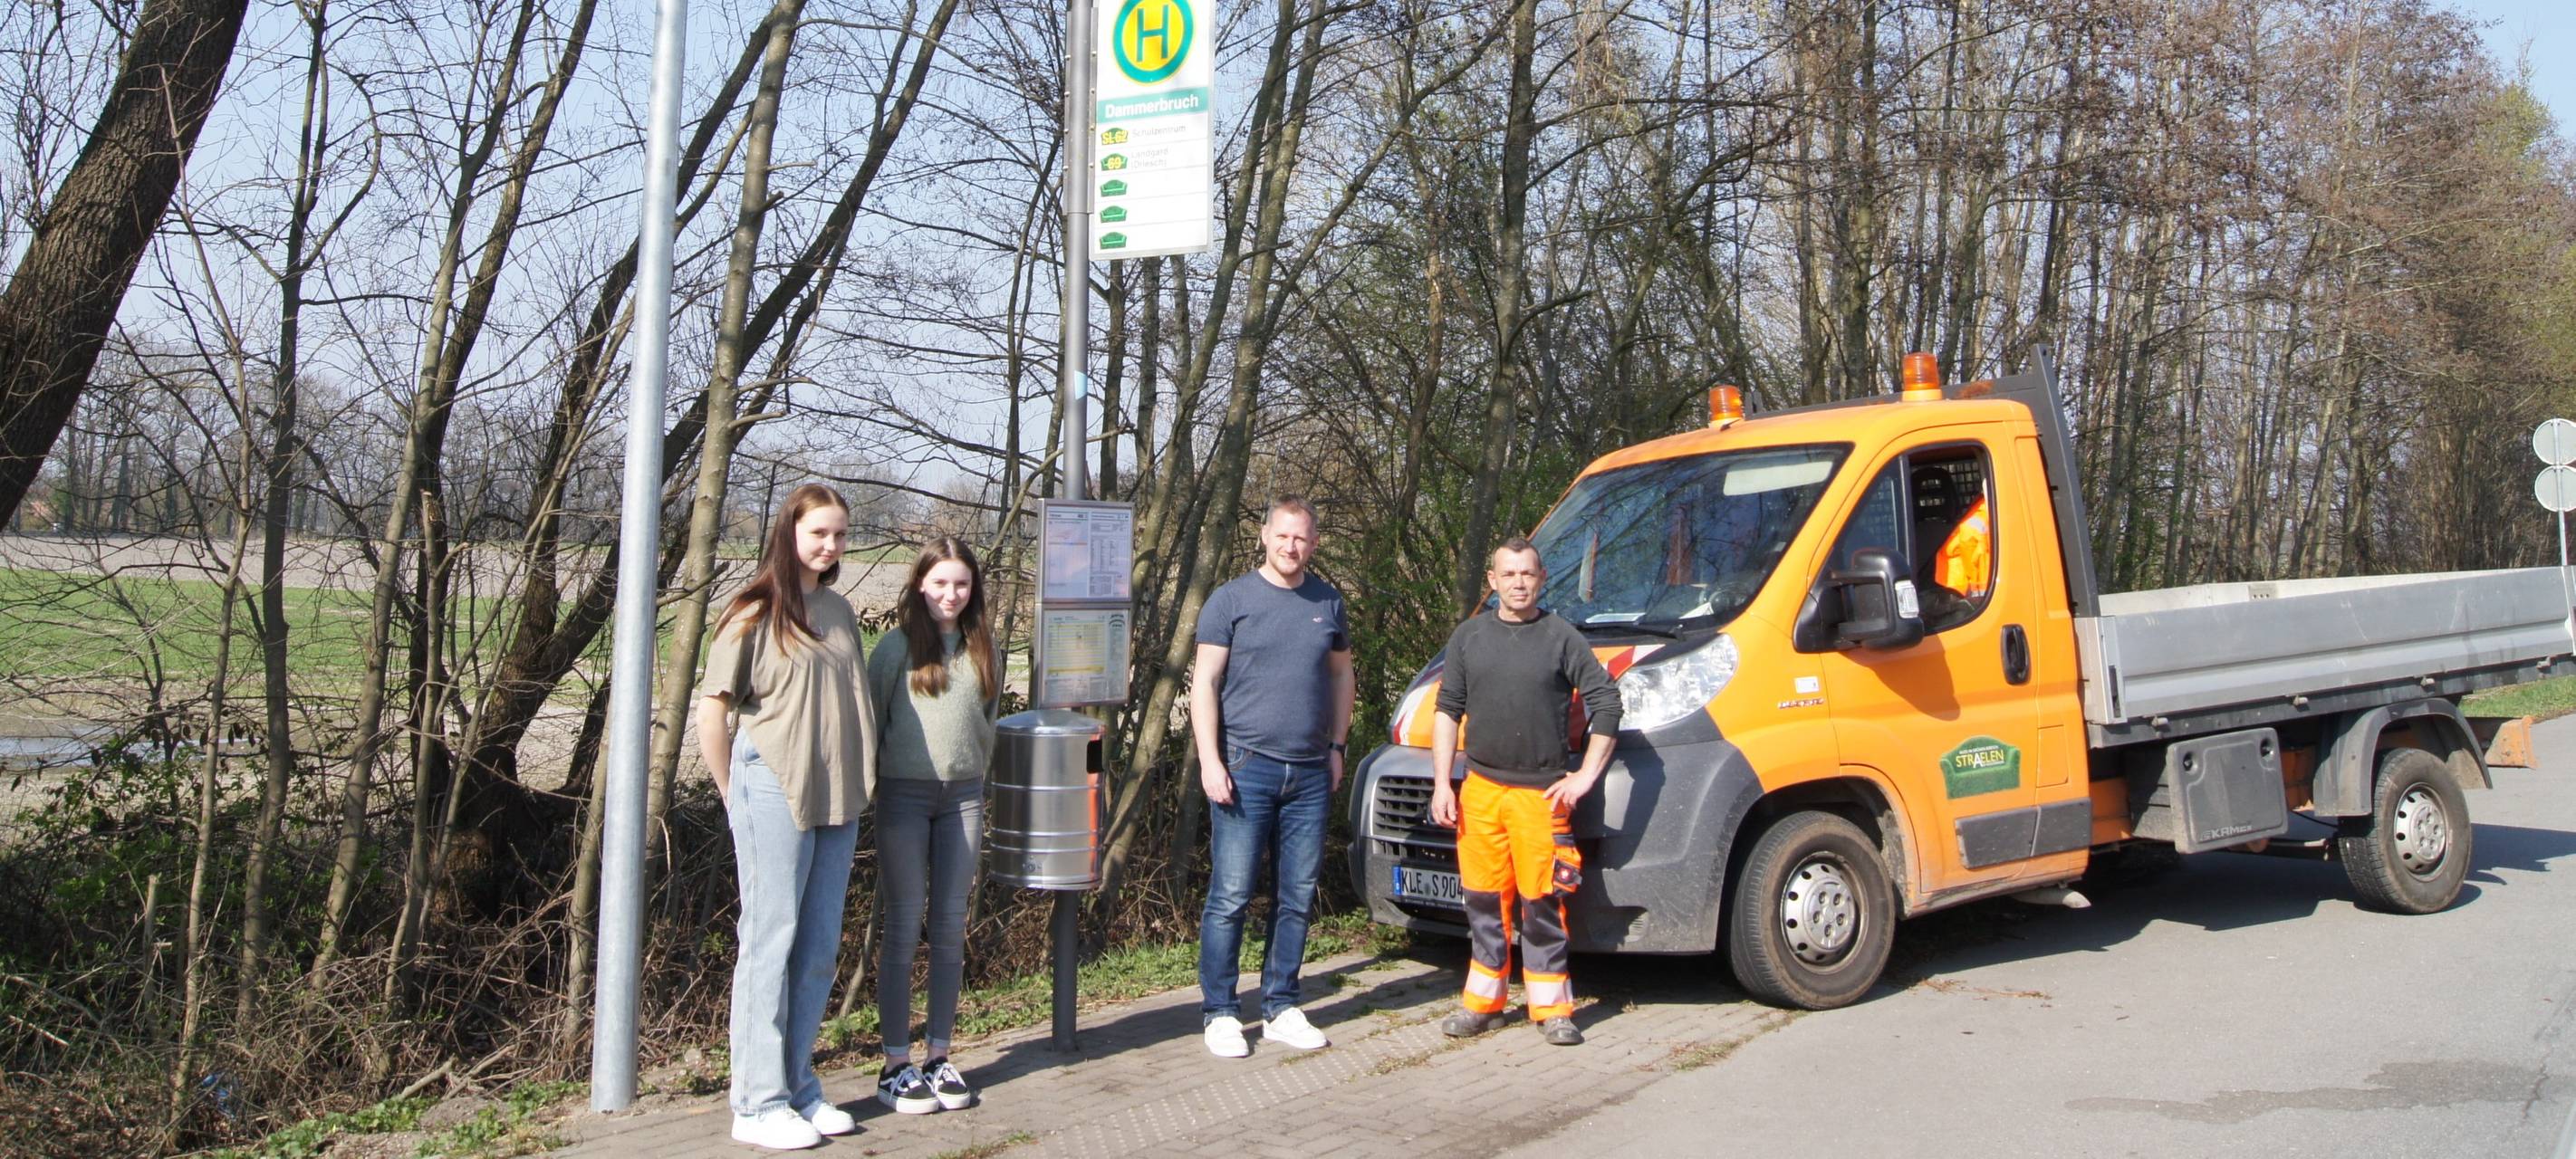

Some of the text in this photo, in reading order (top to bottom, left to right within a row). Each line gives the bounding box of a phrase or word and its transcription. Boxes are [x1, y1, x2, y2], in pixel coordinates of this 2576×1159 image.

[1137, 5, 1168, 62] H
[1104, 94, 1199, 119] Dammerbruch
[1956, 750, 2004, 769] STRAELEN
[1401, 870, 1424, 895] KLE
